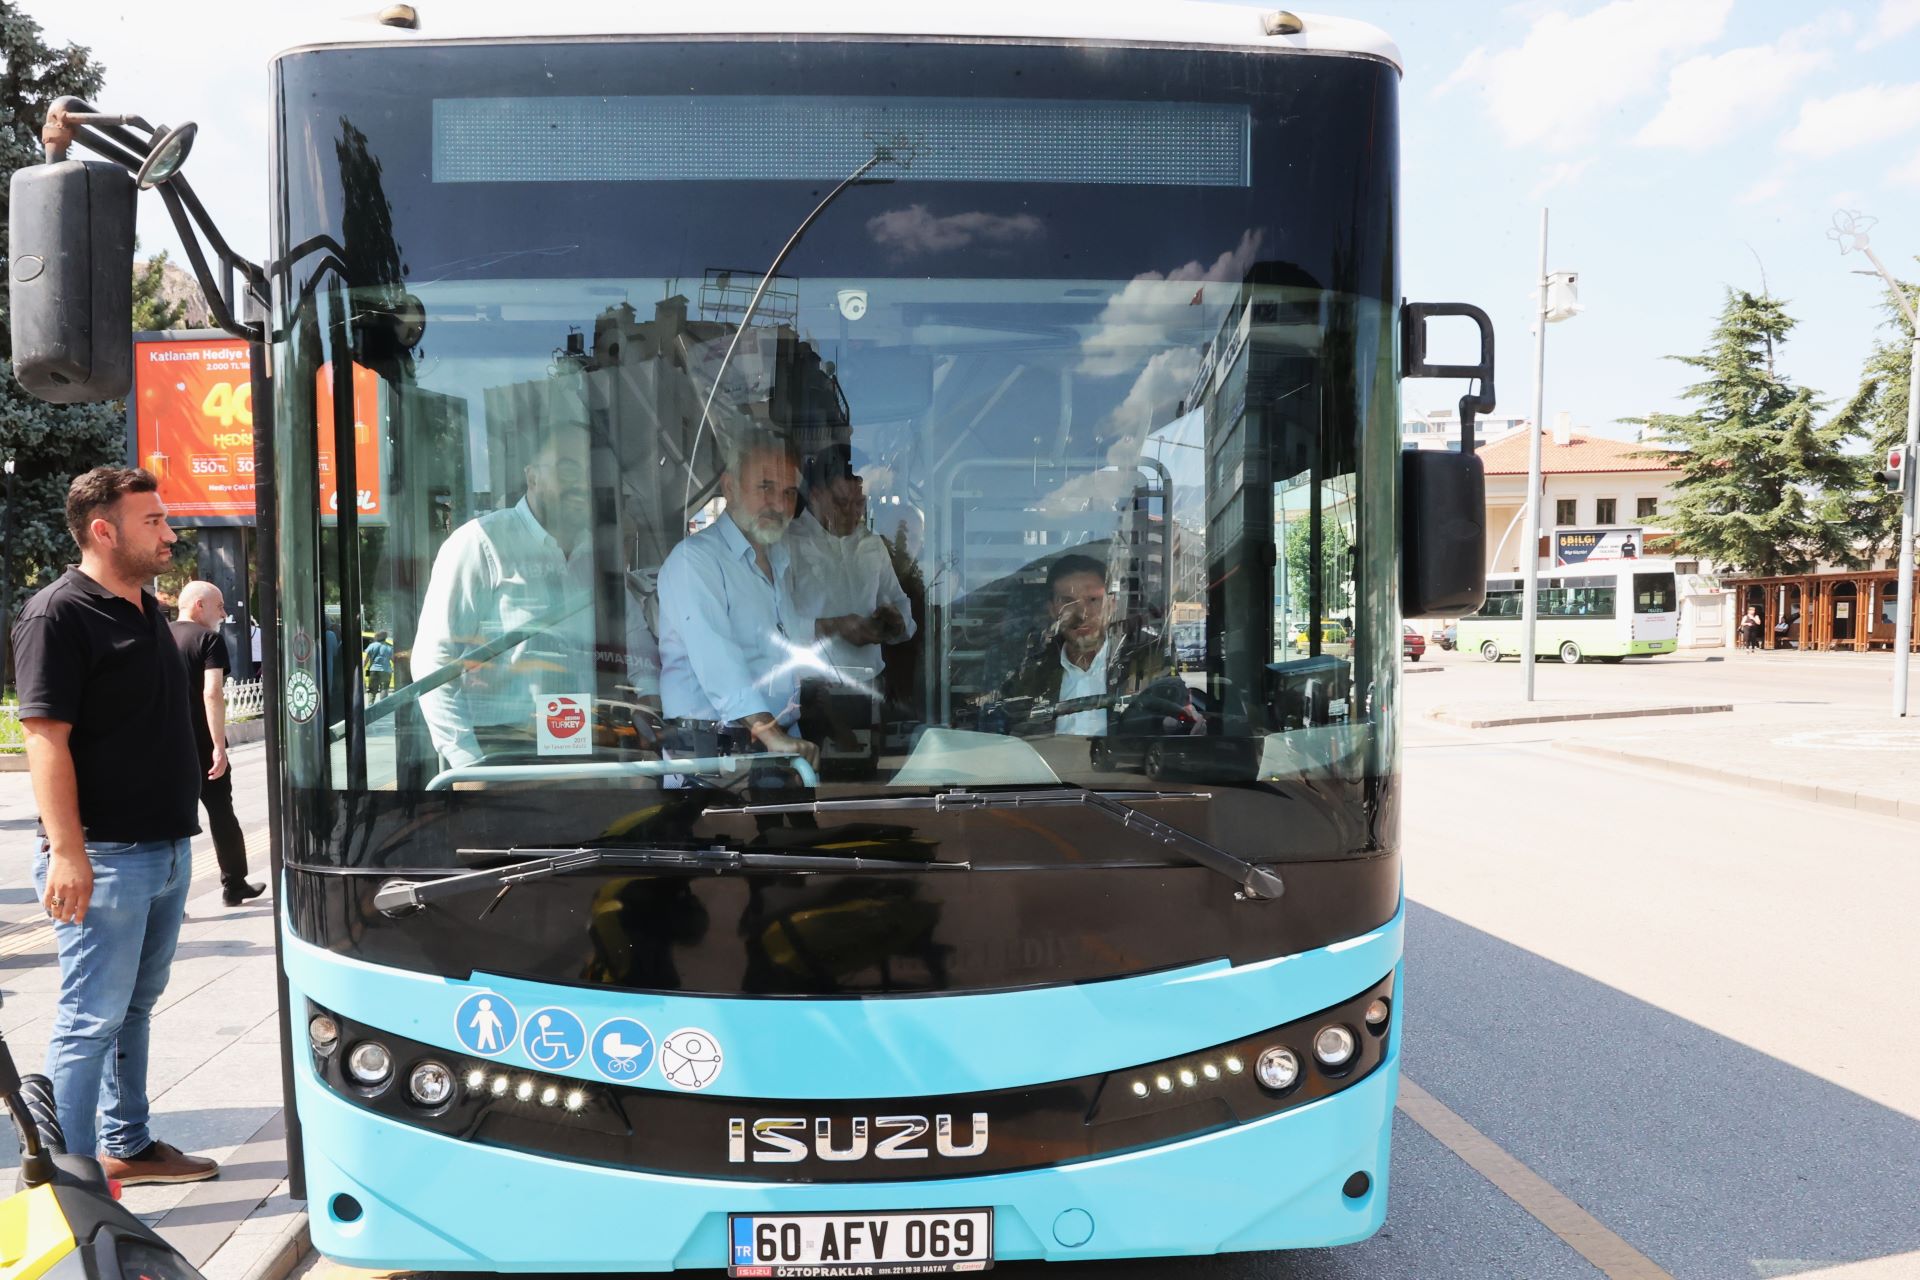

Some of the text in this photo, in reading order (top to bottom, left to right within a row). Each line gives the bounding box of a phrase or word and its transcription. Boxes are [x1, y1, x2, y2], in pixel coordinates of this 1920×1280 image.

[150, 351, 200, 362] Katlanan
[202, 349, 243, 360] Hediye
[206, 363, 229, 371] 2.000
[551, 721, 580, 729] TURKEY
[729, 1112, 989, 1163] ISUZU
[756, 1218, 975, 1262] 60 AFV 069
[735, 1245, 752, 1257] TR
[777, 1266, 873, 1277] ÖZTOPRAKLAR
[922, 1265, 947, 1273] HATAY
